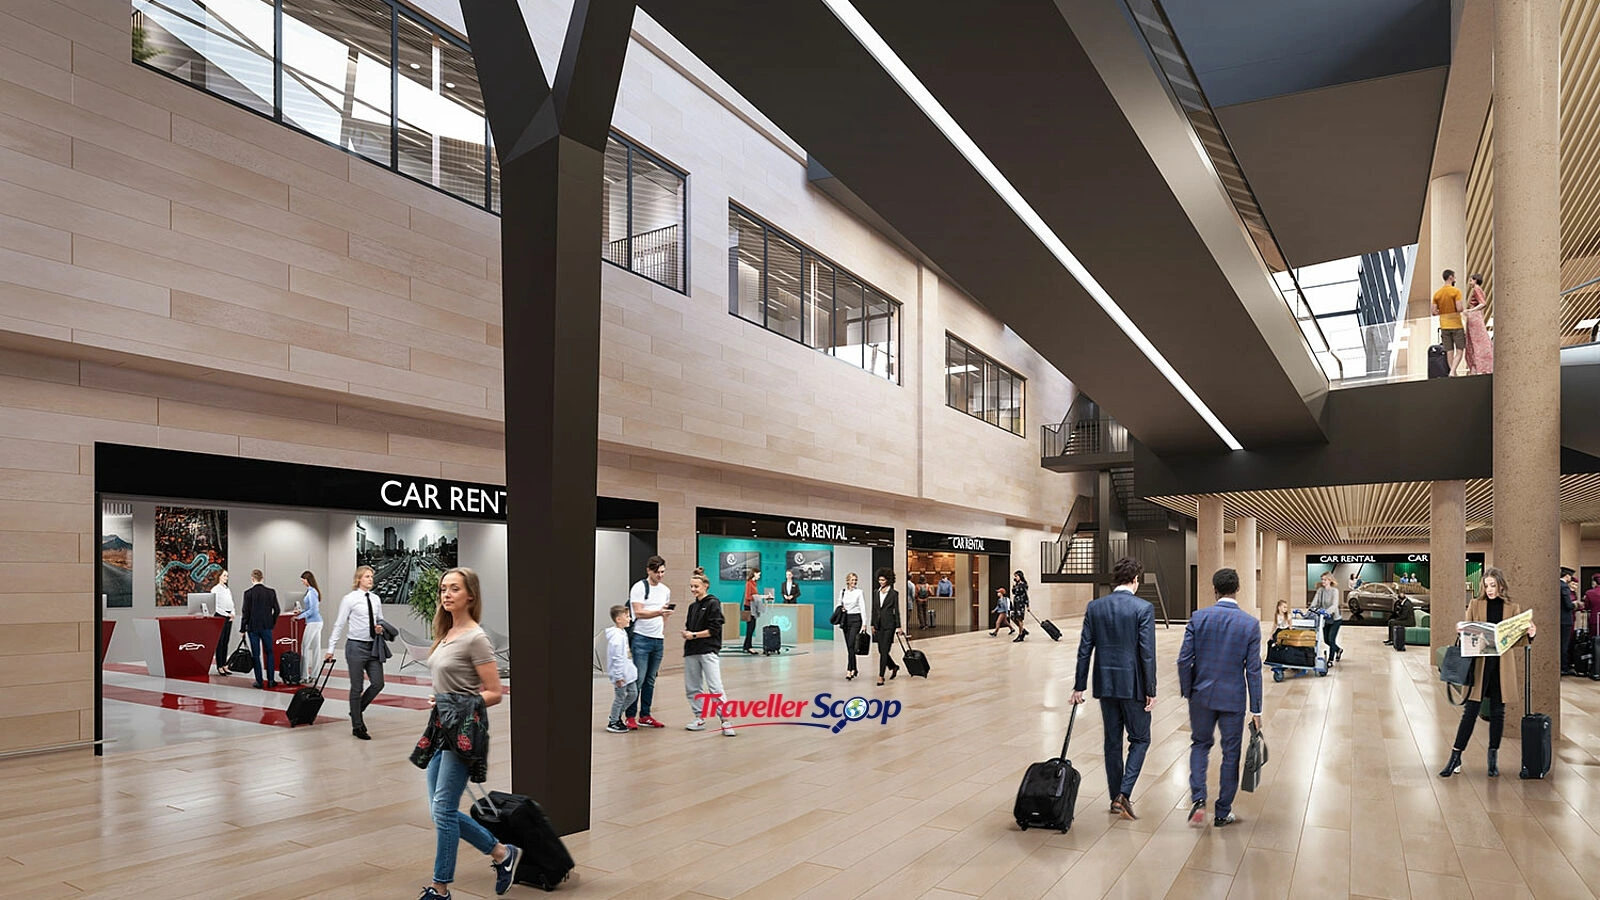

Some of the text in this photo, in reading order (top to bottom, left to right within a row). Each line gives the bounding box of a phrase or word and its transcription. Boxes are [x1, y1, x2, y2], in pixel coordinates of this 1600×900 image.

[380, 480, 442, 510] CAR
[787, 520, 848, 540] CAR RENTAL
[952, 536, 985, 550] CAR RENTAL
[1319, 555, 1376, 563] CAR RENTAL
[1407, 554, 1428, 562] CAR
